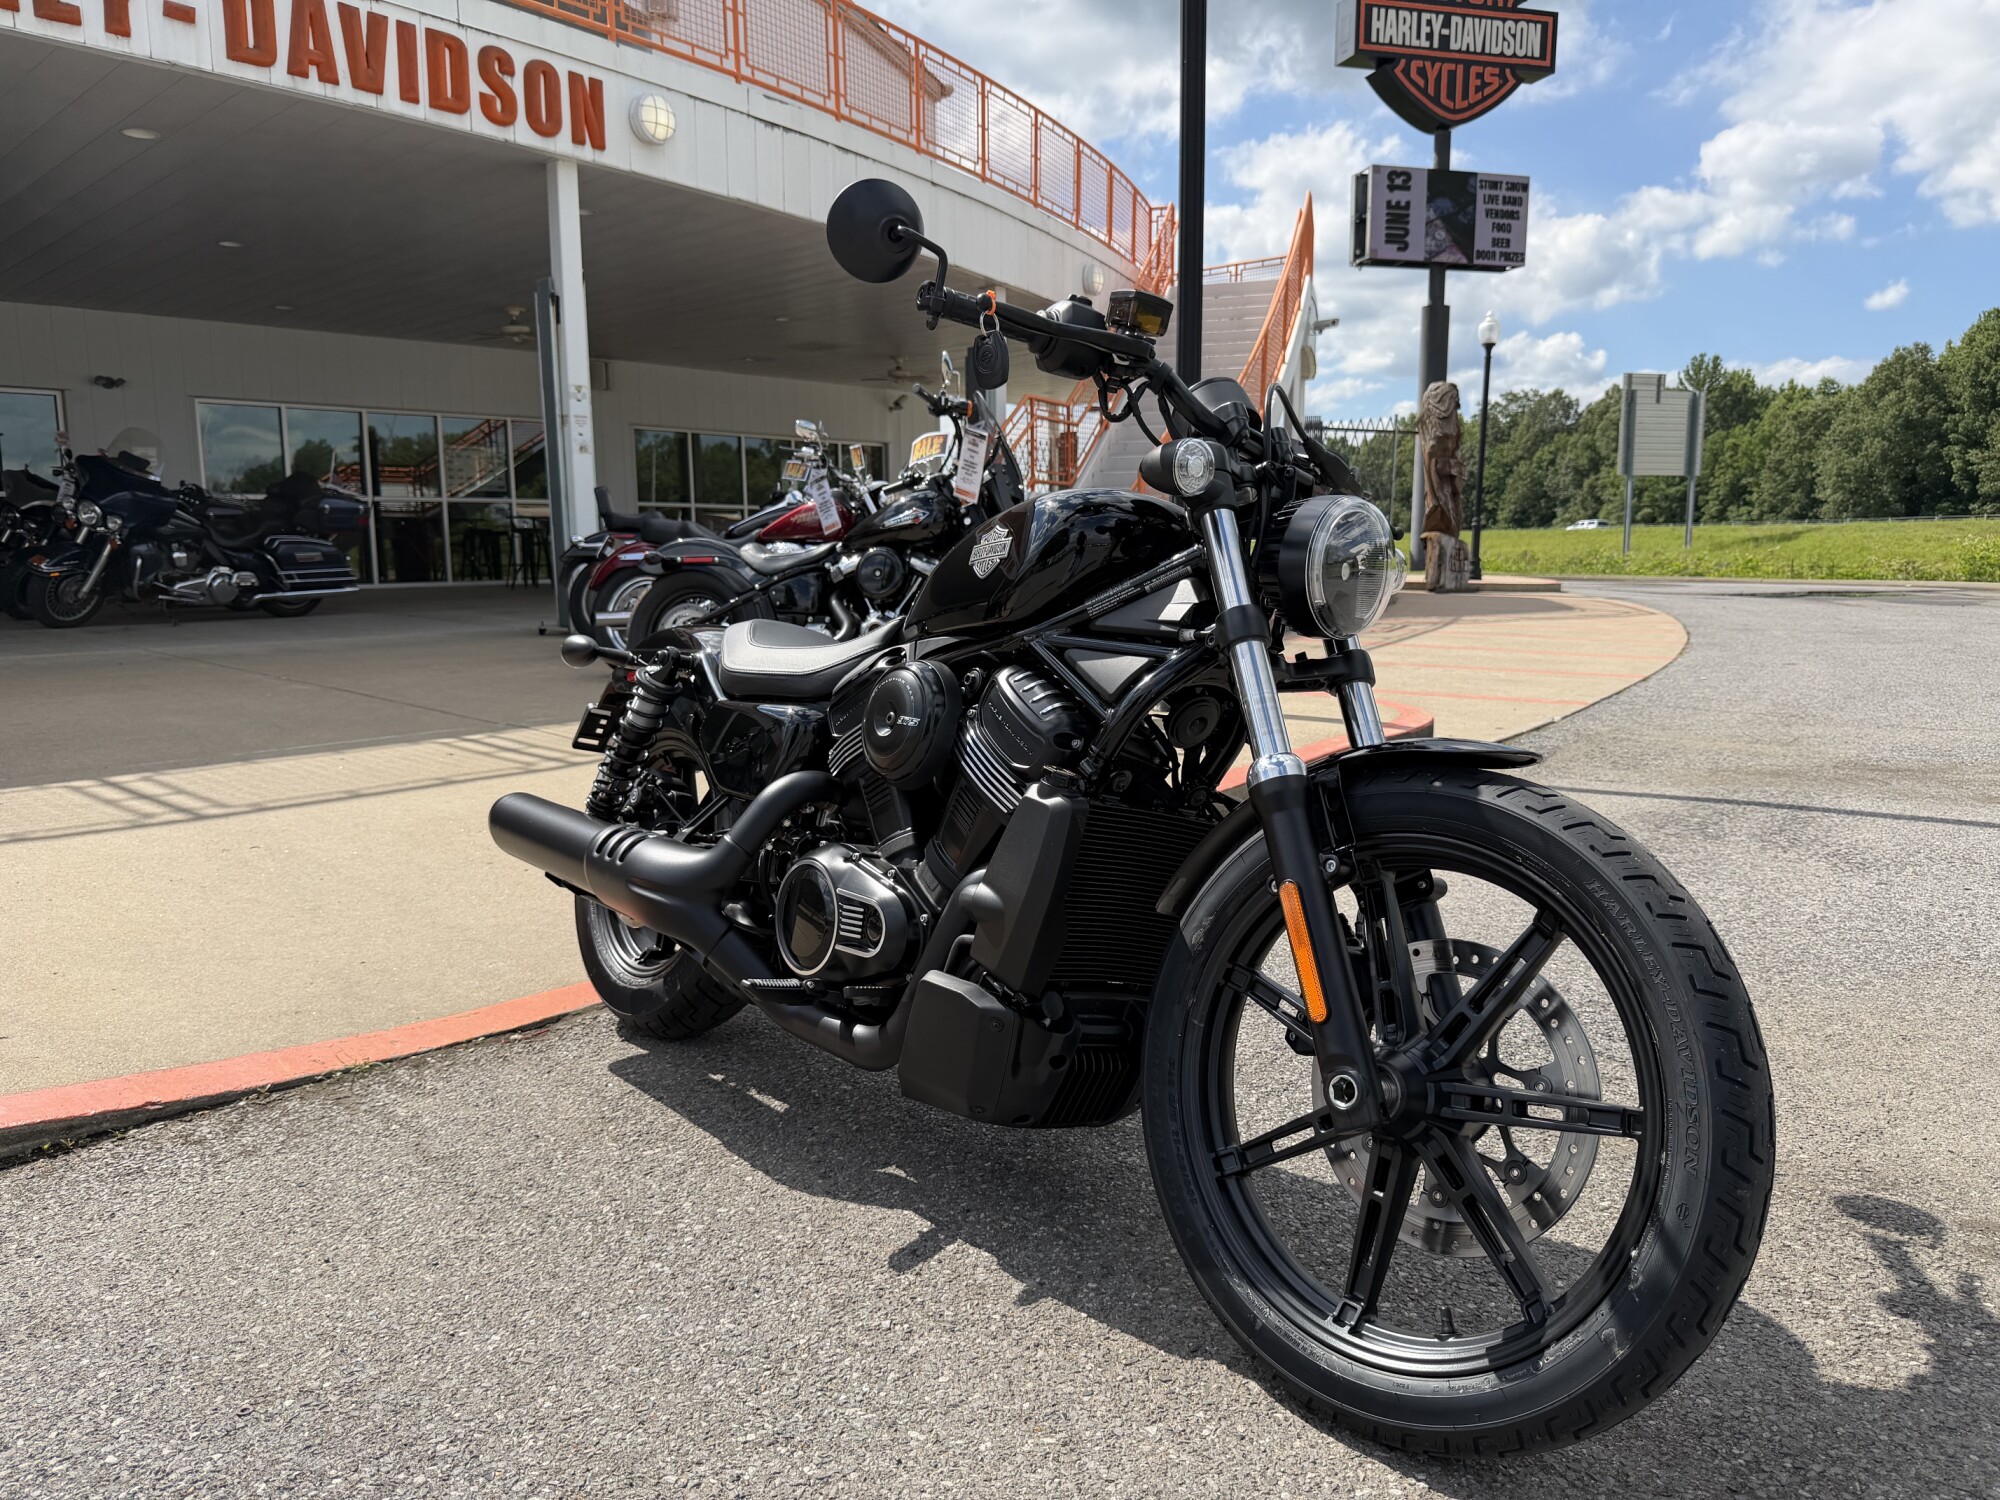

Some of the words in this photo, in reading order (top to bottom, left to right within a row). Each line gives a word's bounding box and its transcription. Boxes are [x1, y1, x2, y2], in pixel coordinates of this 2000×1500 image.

[1370, 6, 1542, 58] HARLEY-DAVIDSON
[1410, 59, 1501, 110] CYCLES
[1386, 170, 1412, 193] 13
[1478, 179, 1503, 191] STUNT
[1505, 181, 1529, 193] SHOW
[1483, 194, 1500, 205] LIVE
[1502, 195, 1524, 207] BAND
[1485, 208, 1520, 221] VENDORS
[1384, 200, 1411, 252] JUNE
[1491, 222, 1512, 234] FOOD
[1491, 237, 1511, 248] BEER
[1475, 249, 1496, 261] DOOR
[1498, 251, 1525, 263] PRIZES
[912, 435, 945, 462] SALE
[1583, 878, 1700, 1180] HARLEY-DAVIDSON
